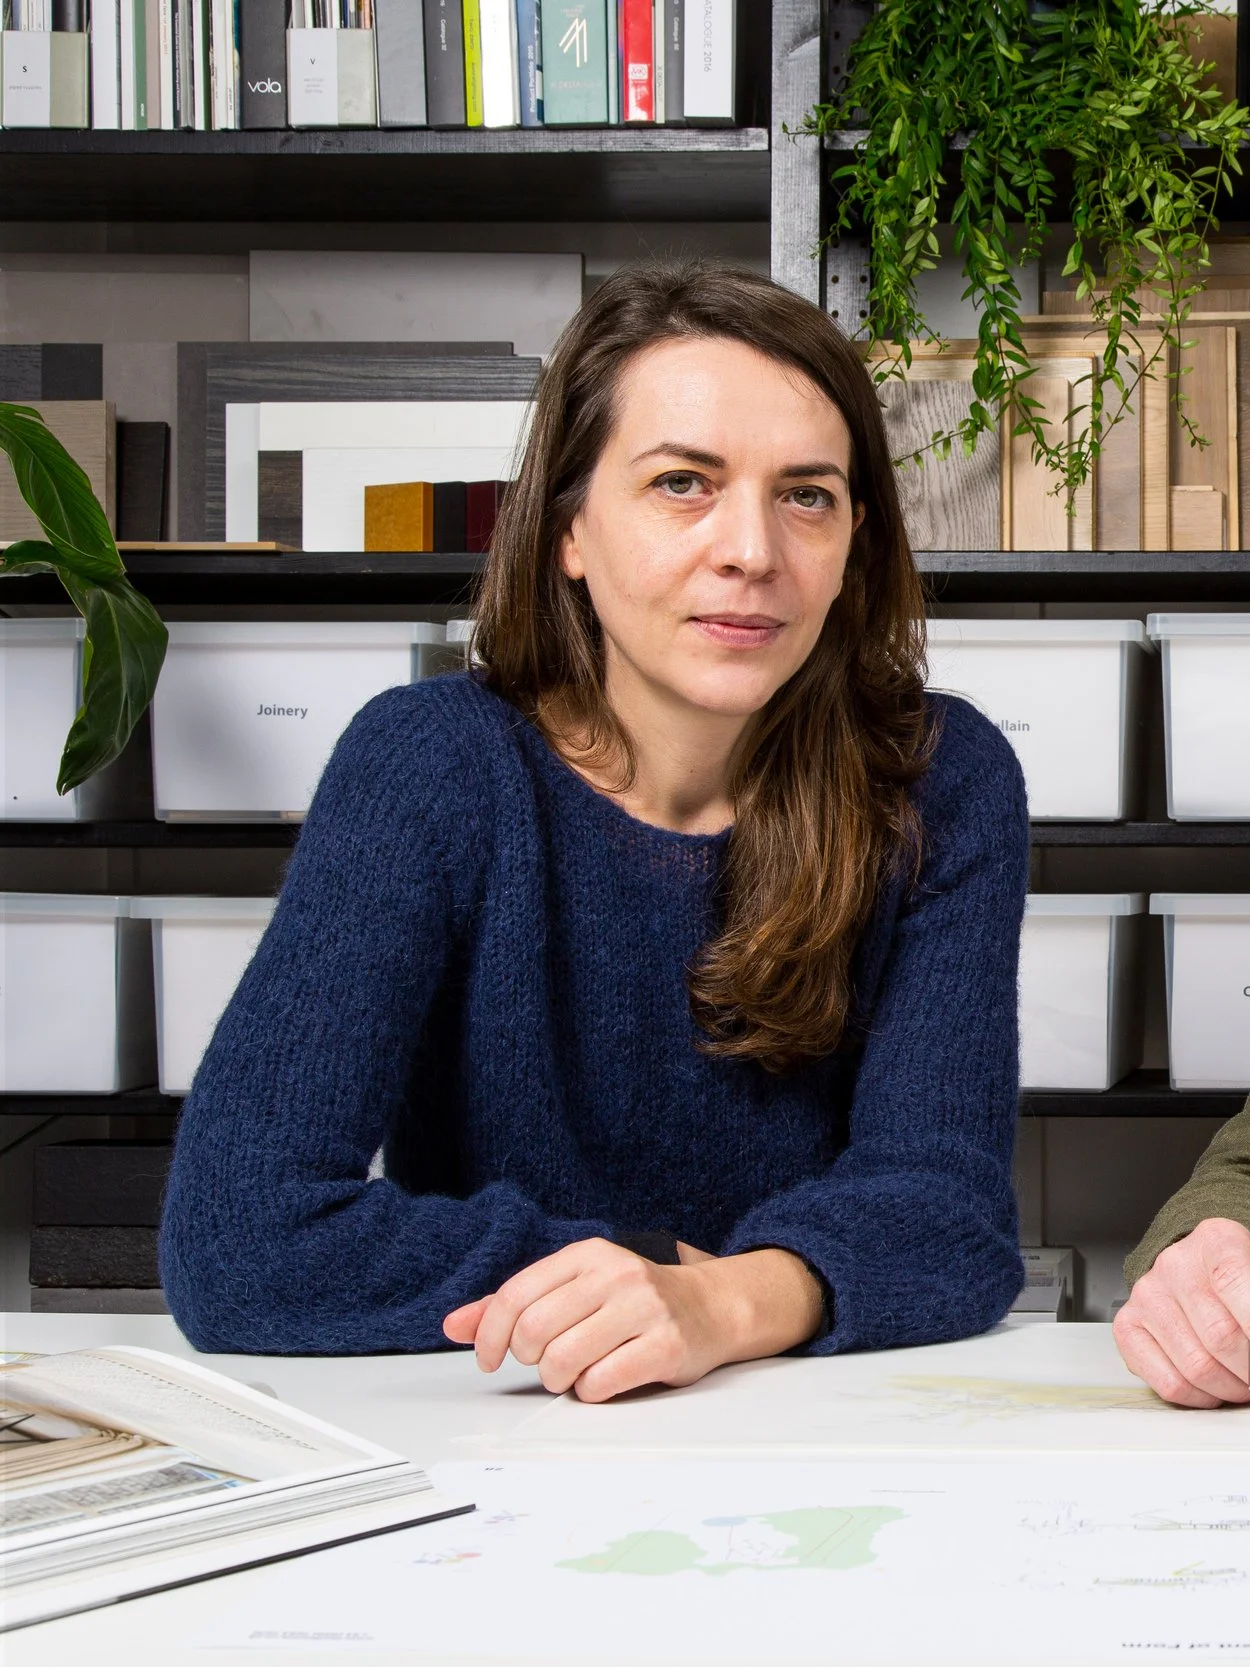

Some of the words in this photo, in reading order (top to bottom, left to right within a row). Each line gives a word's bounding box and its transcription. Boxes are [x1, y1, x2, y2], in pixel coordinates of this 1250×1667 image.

[703, 51, 712, 72] 2016
[248, 78, 282, 94] vola
[256, 704, 309, 719] Joinery
